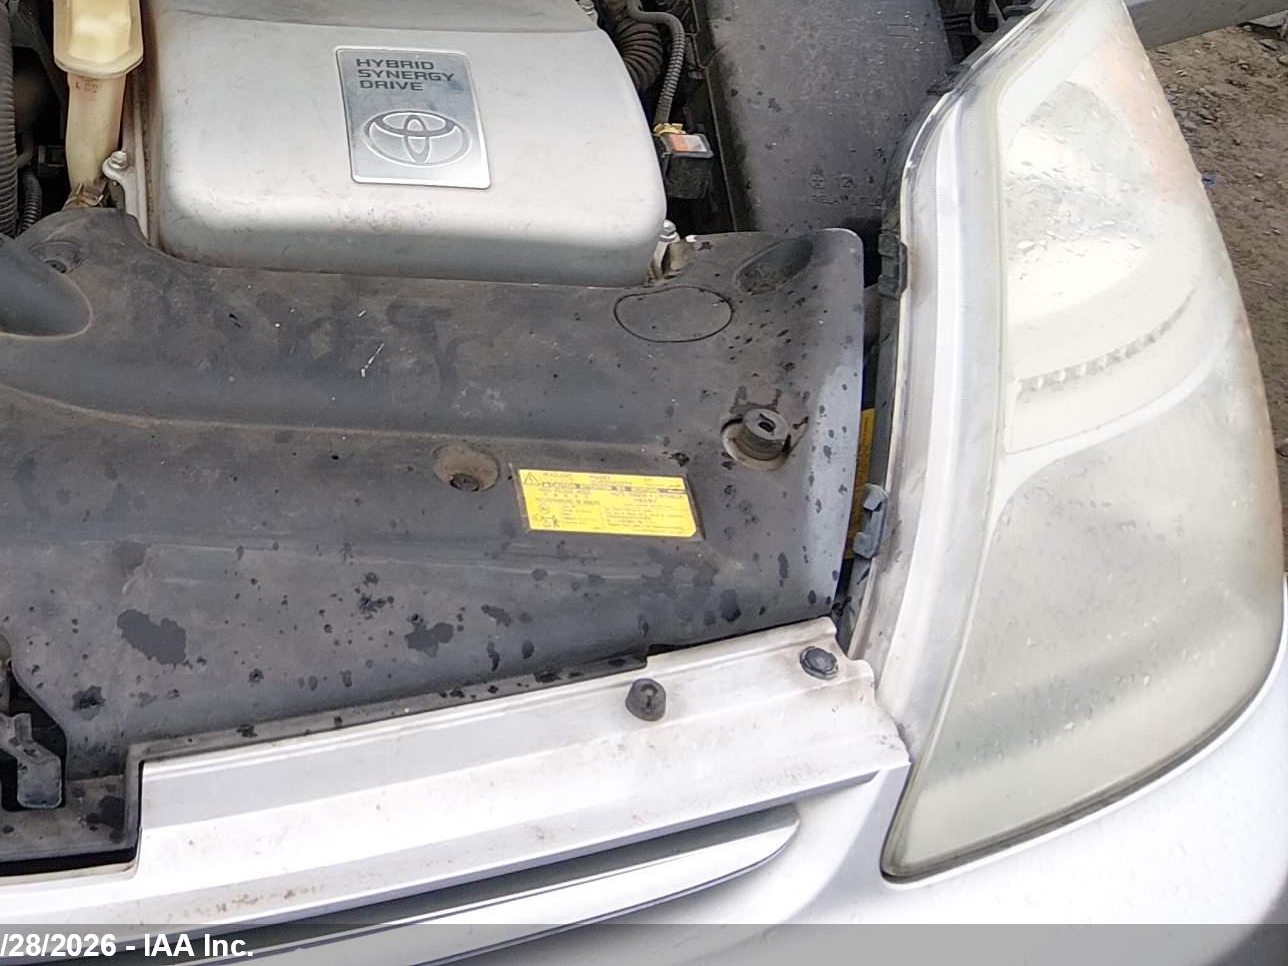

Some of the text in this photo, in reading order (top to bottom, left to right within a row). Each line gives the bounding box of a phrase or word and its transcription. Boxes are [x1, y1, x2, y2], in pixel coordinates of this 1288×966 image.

[355, 58, 435, 70] HYBRID
[357, 68, 455, 82] SYNERGY
[359, 79, 424, 91] DRIVE
